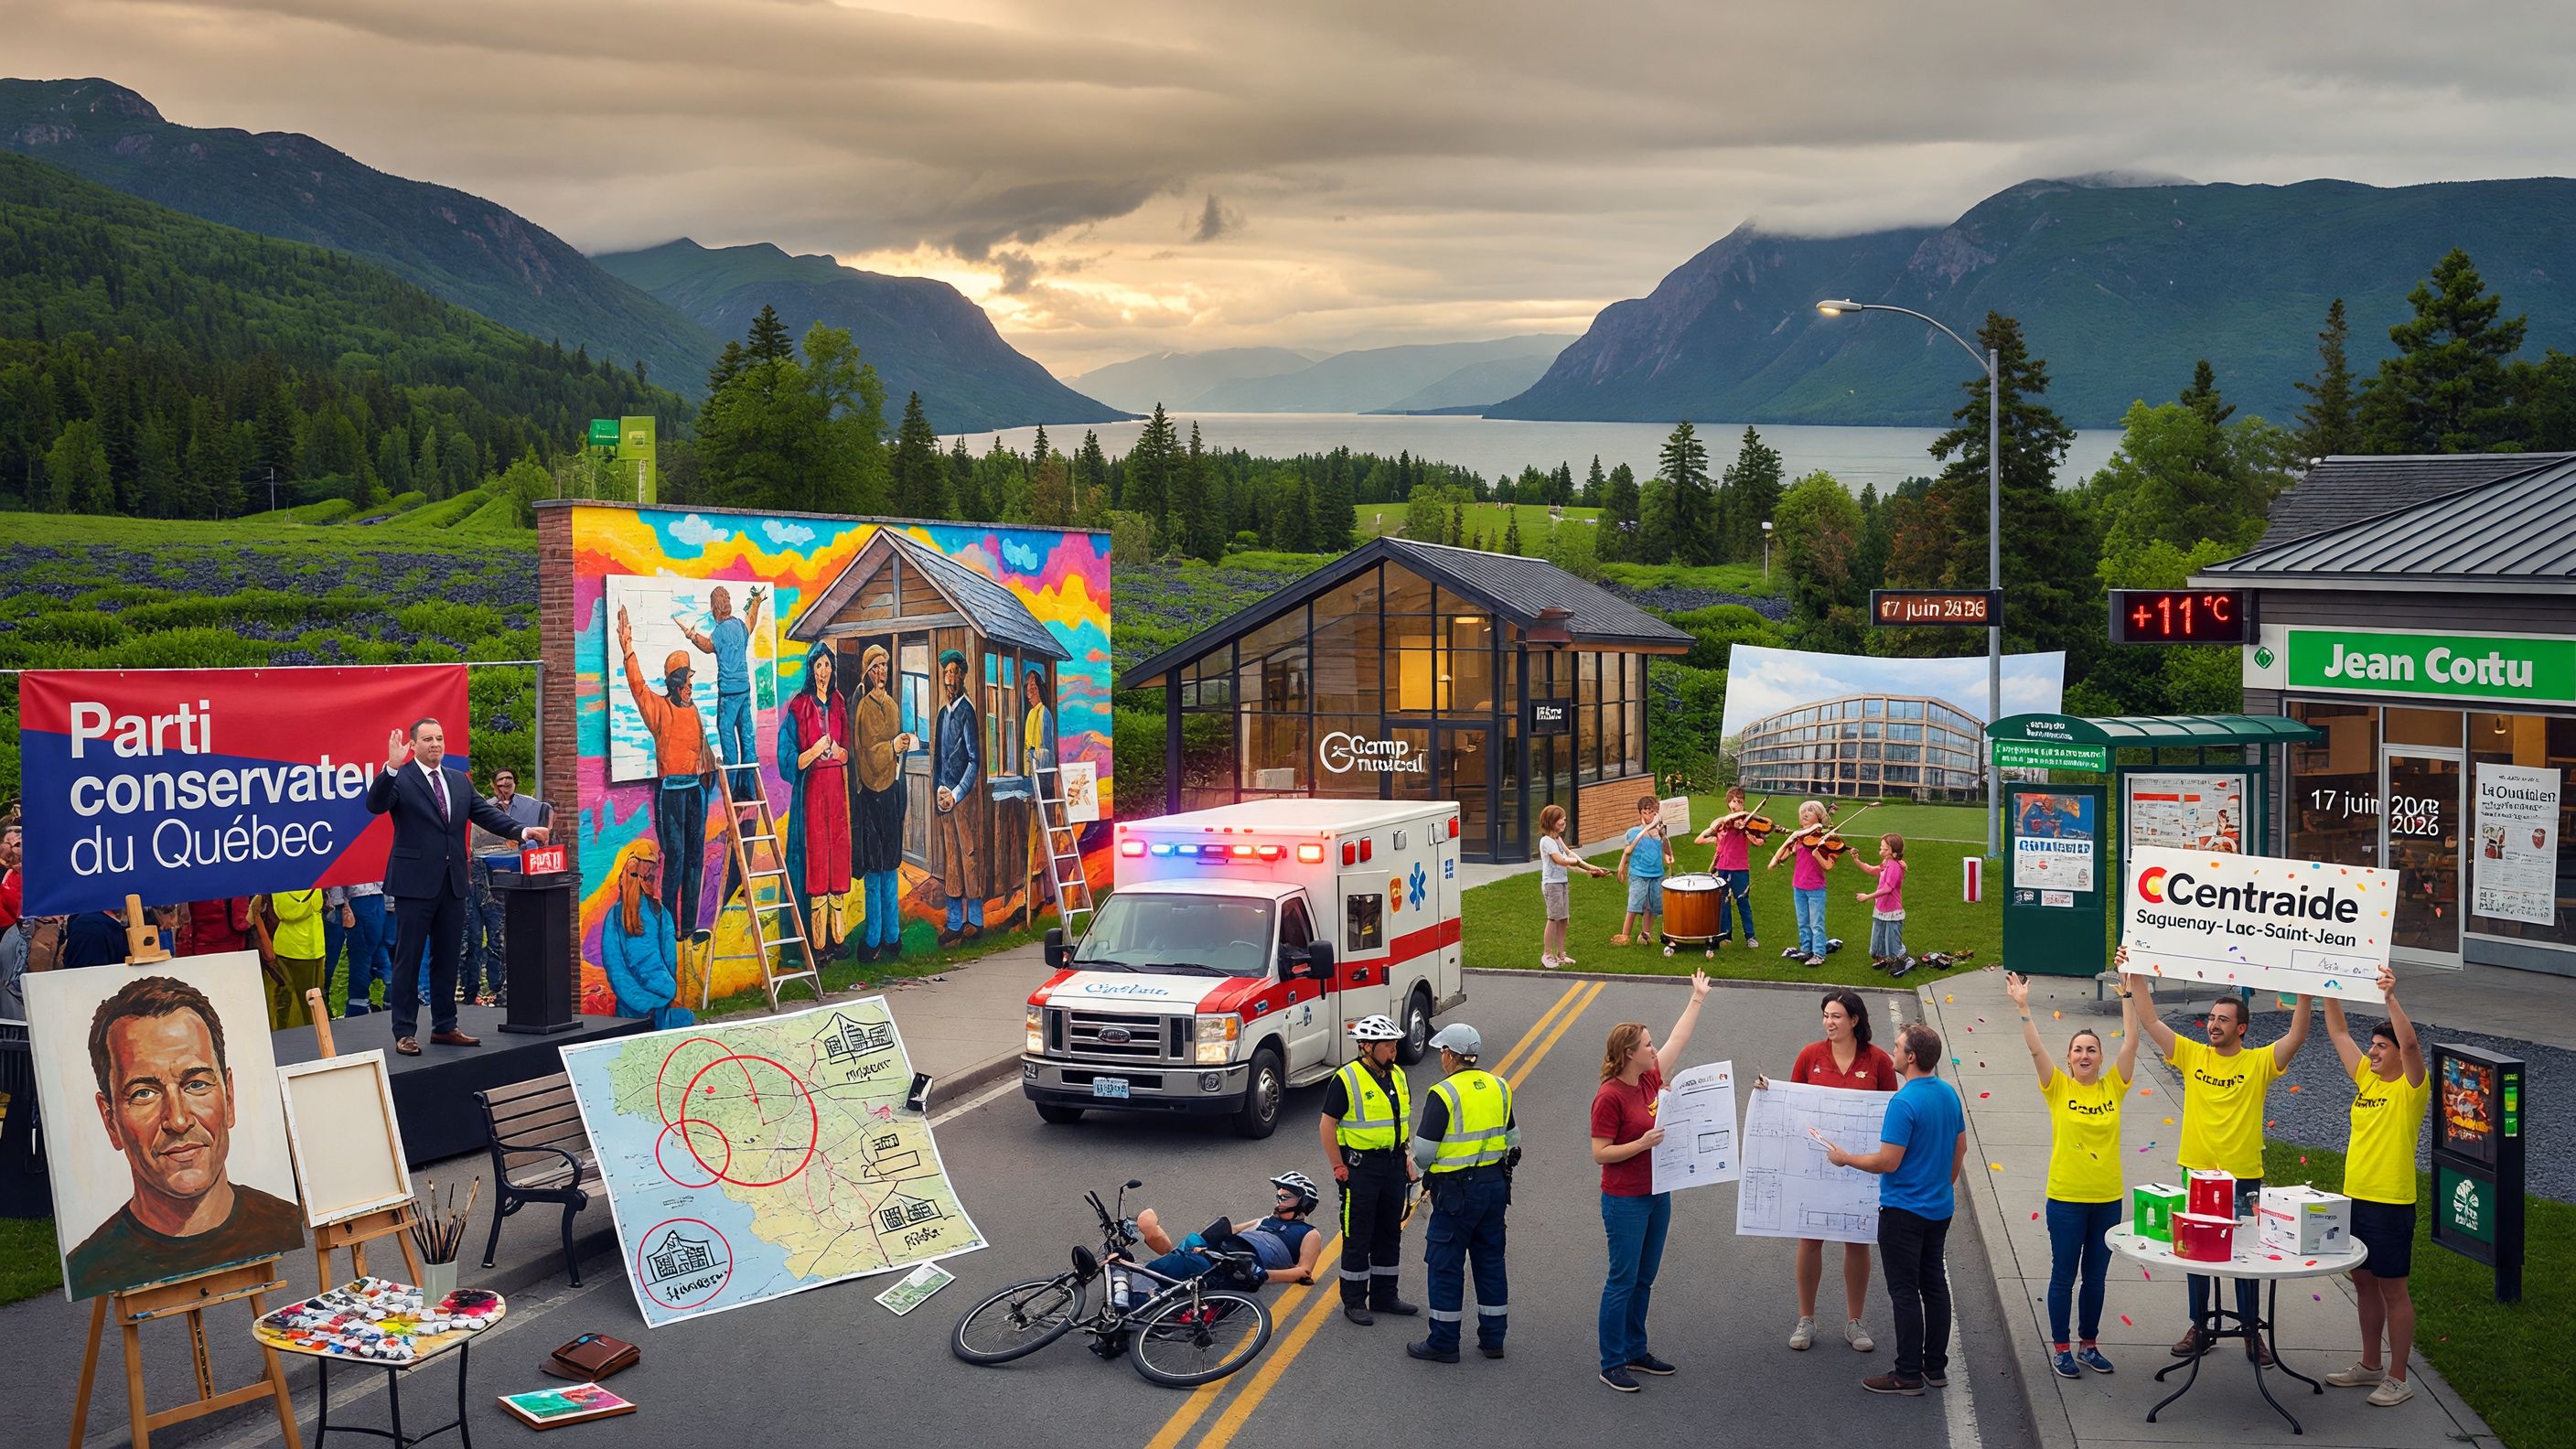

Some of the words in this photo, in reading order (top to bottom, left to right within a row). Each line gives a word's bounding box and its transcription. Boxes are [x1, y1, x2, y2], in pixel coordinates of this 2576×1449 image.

[1882, 600, 1900, 617] 17
[1905, 598, 1939, 621] juin
[2324, 643, 2415, 682] Jean
[70, 699, 211, 758] Parti
[70, 754, 374, 817] conservate
[2311, 789, 2337, 810] 17
[2342, 790, 2381, 819] juin
[70, 824, 134, 876] du
[152, 813, 333, 868] Québec
[2390, 815, 2440, 836] 2026
[2167, 873, 2358, 923] Centraide
